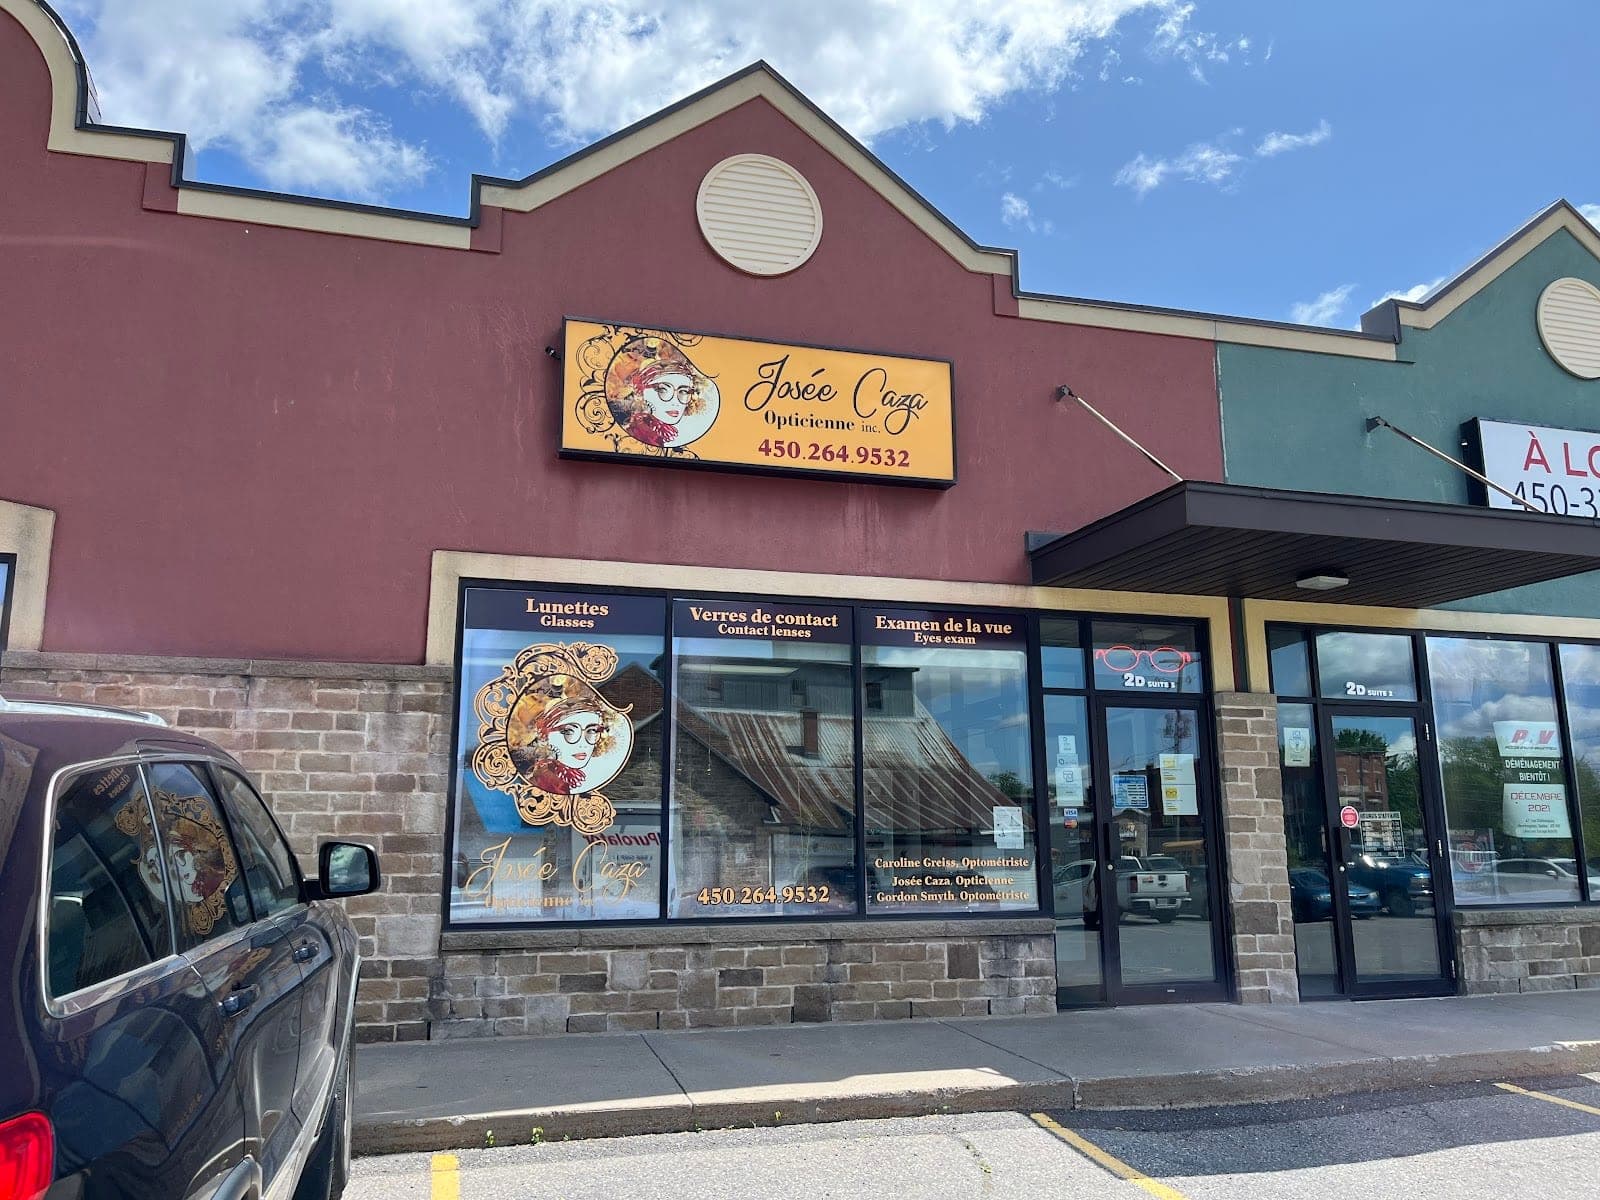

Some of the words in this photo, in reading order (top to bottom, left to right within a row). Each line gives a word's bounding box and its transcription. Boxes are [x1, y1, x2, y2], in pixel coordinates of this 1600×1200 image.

[744, 353, 838, 412] Josée
[853, 367, 929, 436] Caza
[764, 410, 856, 432] Opticienne
[860, 420, 882, 434] inc.
[757, 438, 911, 469] 450.264.9532
[1523, 430, 1552, 474] À
[1511, 481, 1600, 518] 450-3
[525, 598, 610, 617] Lunettes
[540, 615, 595, 629] Glasses
[689, 607, 747, 623] Verres
[751, 608, 773, 624] de
[776, 612, 839, 628] contact
[717, 624, 768, 637] Contact
[771, 626, 812, 639] lenses
[874, 615, 940, 632] Examen
[944, 617, 963, 633] de
[966, 618, 981, 633] la
[984, 622, 1013, 635] vue
[914, 632, 941, 645] Eyes
[943, 635, 977, 645] exam
[1123, 673, 1145, 687] 2D
[1346, 682, 1366, 695] 2D
[1505, 758, 1560, 769] DÉMÉNAGEMENT
[1518, 771, 1546, 782] BIENTÔT
[1510, 791, 1563, 801] DÉCEMBRE
[1527, 804, 1551, 813] 2021
[874, 857, 920, 869] Caroline
[961, 857, 1029, 871] Optométriste
[572, 839, 648, 905] Caza
[892, 875, 922, 887] Josée
[955, 875, 1014, 888] Opticienne
[697, 885, 830, 906] 450.264.9532
[876, 891, 918, 903] Gordon
[959, 890, 1029, 903] Optométriste
